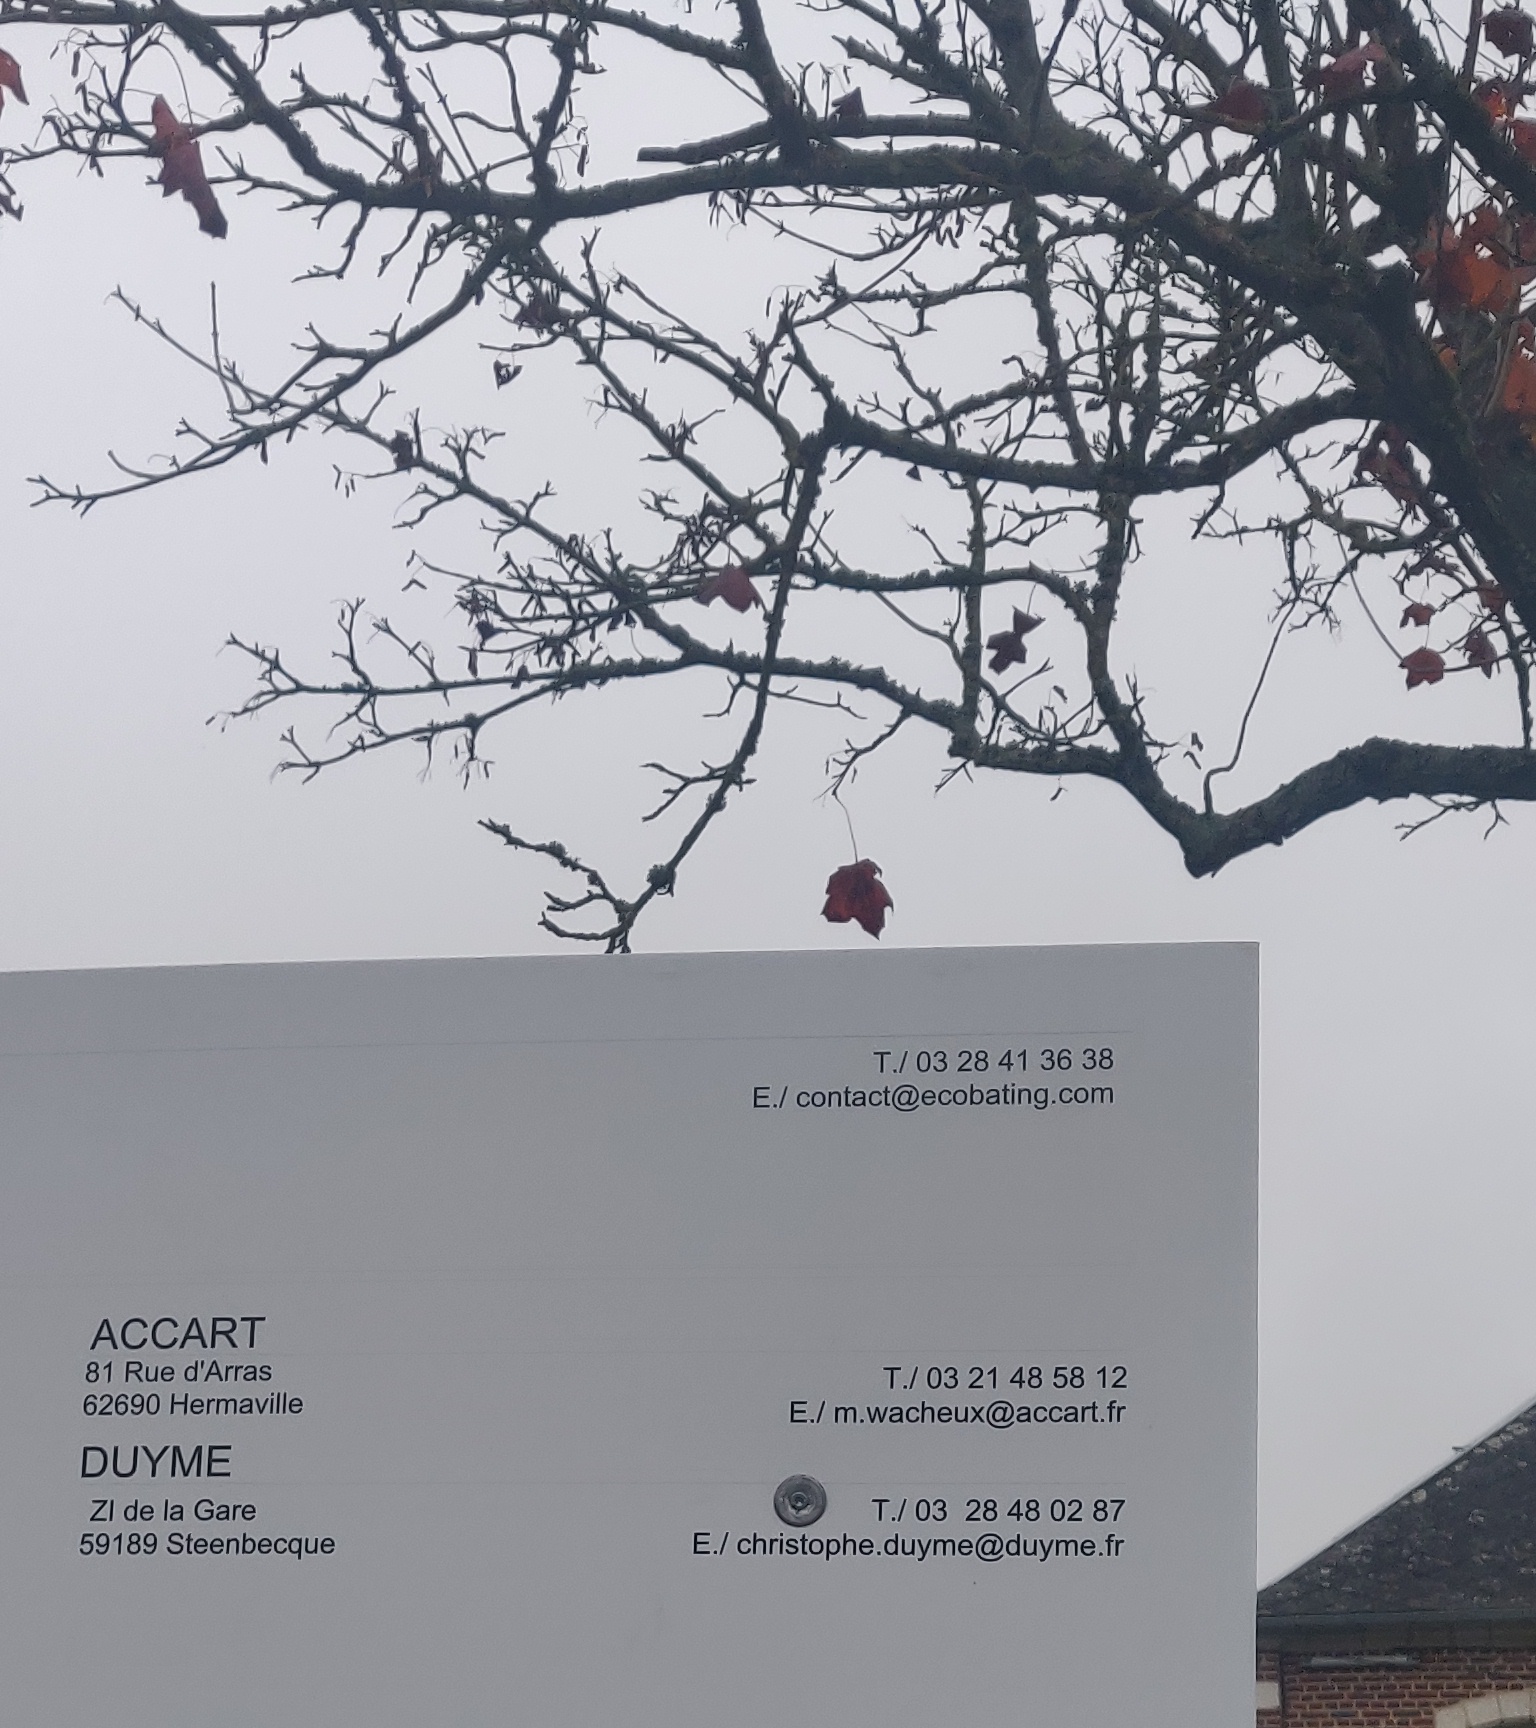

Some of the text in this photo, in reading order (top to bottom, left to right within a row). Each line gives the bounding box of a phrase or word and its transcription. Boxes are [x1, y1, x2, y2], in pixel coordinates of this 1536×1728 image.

[873, 1047, 1114, 1074] T./ 03 28 41 36 38
[753, 1082, 1114, 1112] E./ contact@ecobating.com
[89, 1316, 267, 1351] ACCART
[85, 1359, 272, 1384] 81 Rue d'Arras
[882, 1365, 1128, 1390] T./ 03 21 48 58 12
[83, 1391, 304, 1416] 62690 Hermaville
[790, 1399, 1127, 1429] E./ m.wacheux@accart.fr
[80, 1444, 232, 1479] DUYME
[89, 1498, 257, 1522] ZI de la Gare
[871, 1498, 1126, 1523] T./ 03 28 48 02 87
[79, 1532, 336, 1561] 59189 Steenbecque
[693, 1531, 1125, 1563] E./ christophe.duyme@duyme.fr
